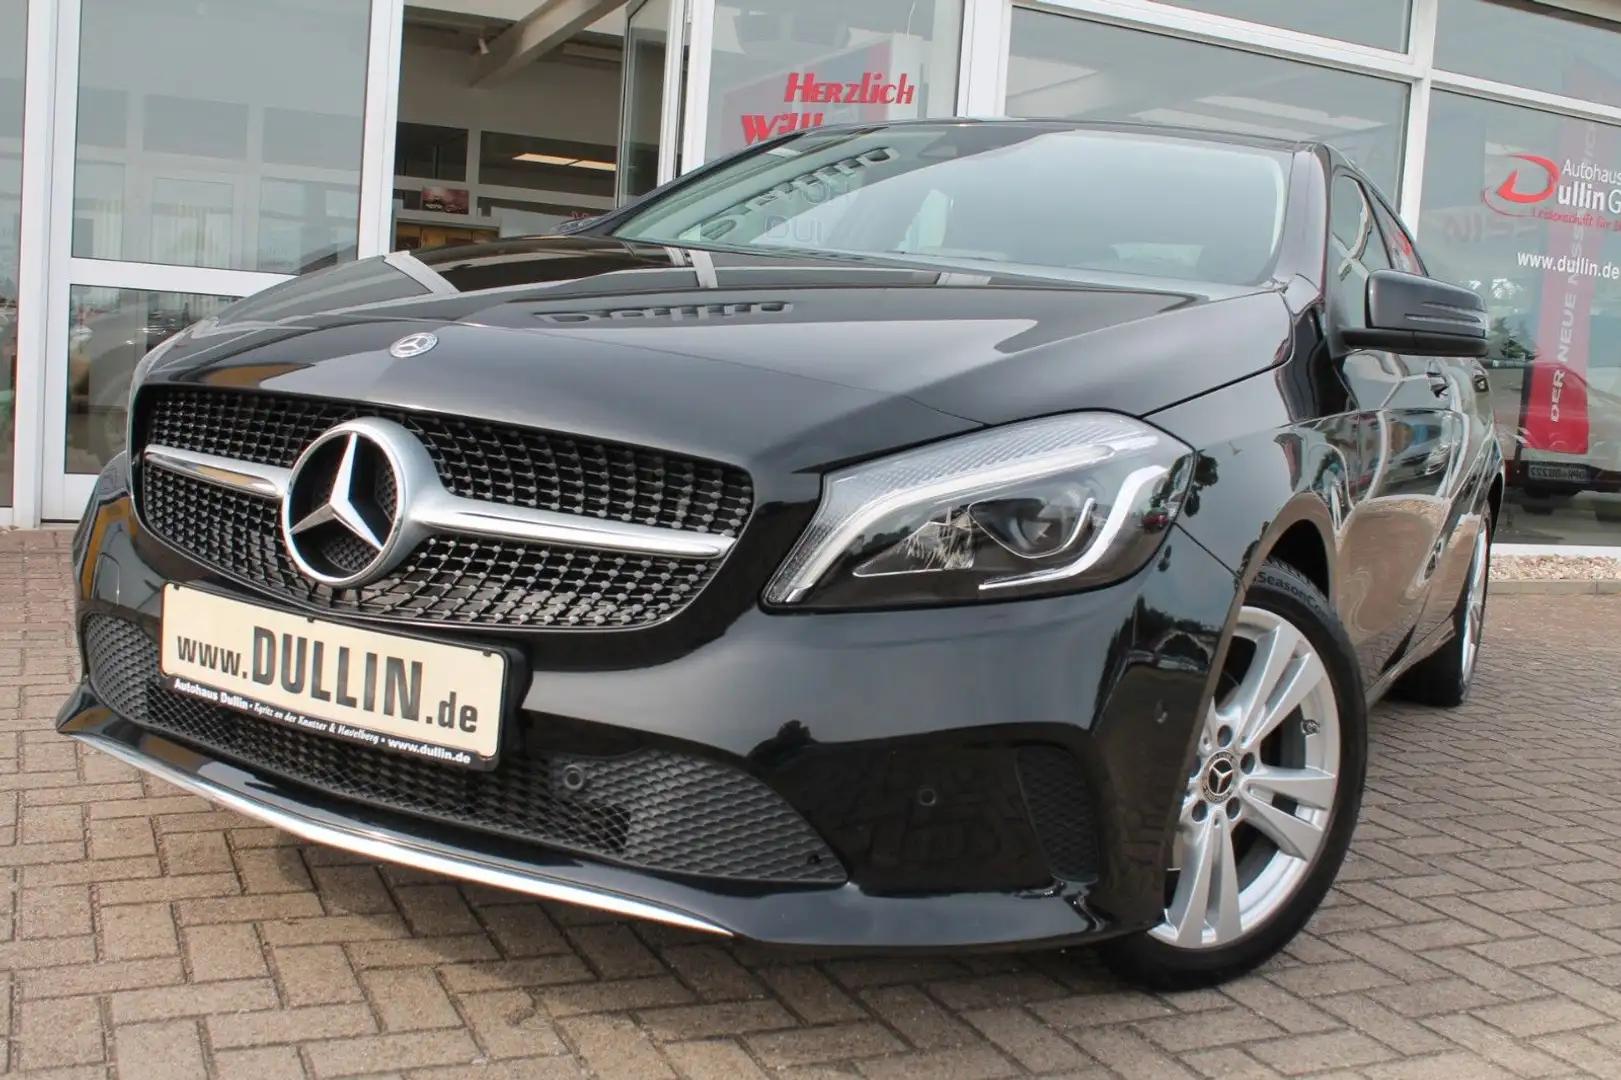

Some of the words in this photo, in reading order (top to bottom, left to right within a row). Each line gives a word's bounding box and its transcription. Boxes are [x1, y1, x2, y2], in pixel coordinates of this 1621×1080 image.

[1562, 159, 1621, 186] Autohaus
[1517, 252, 1621, 280] www.dullin.de
[1557, 292, 1577, 362] NEUE
[1551, 369, 1565, 422] DER
[176, 625, 479, 733] www.DULLIN.de
[173, 677, 219, 701] Autohaus
[220, 691, 249, 711] Dullin
[328, 722, 336, 734] &
[387, 738, 472, 765] www.dullin.de
